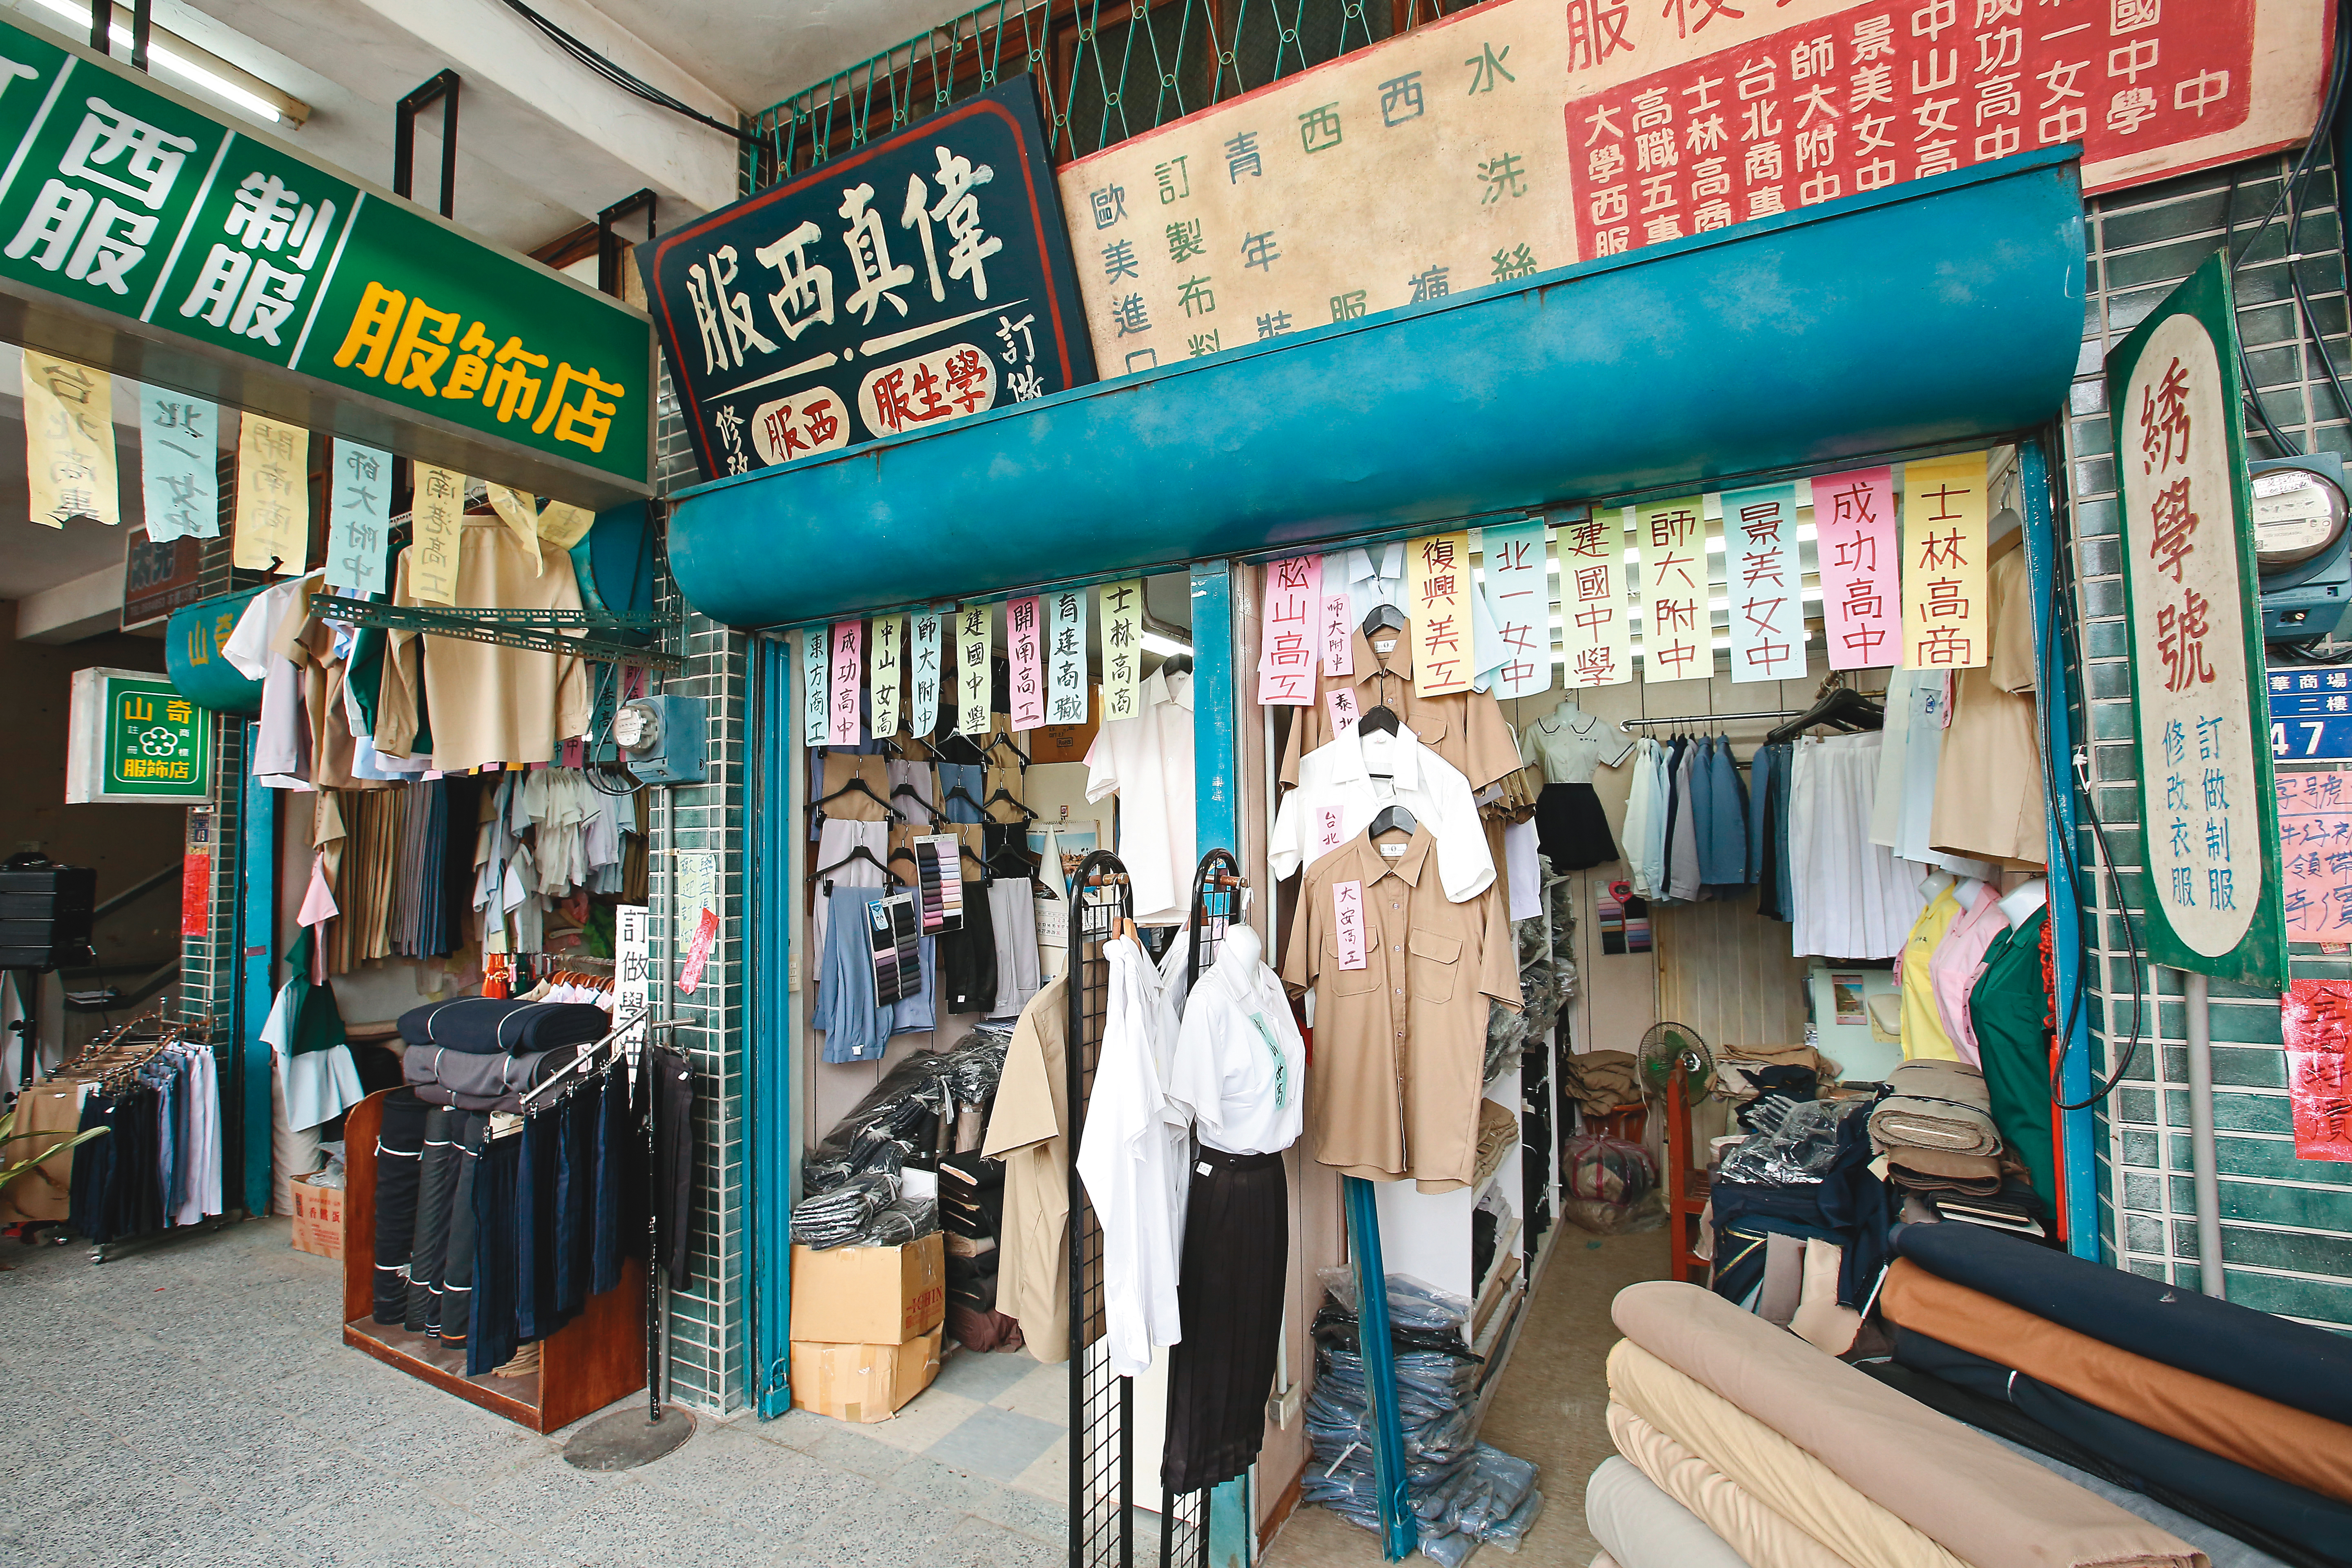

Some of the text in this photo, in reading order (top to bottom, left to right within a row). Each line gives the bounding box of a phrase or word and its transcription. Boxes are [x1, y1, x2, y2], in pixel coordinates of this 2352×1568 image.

[1735, 56, 1786, 222] 台北商專
[1790, 33, 1841, 205] 師大附中
[1850, 13, 1897, 192] 景美女中
[2035, 0, 2092, 144] 一女中
[4, 96, 196, 296] 西服
[1465, 42, 1538, 285] 水洗絲
[1584, 104, 1628, 257] 大學西服
[1632, 86, 1684, 245] 高職五專
[1682, 75, 1732, 234] 士林高商
[180, 171, 336, 347] 制服
[332, 281, 625, 453] 服飾店
[1265, 556, 1312, 700] 松山高工
[1421, 538, 1466, 690] 復興美工
[1497, 540, 1537, 693] 北一女中
[1568, 522, 1615, 687] 建國中學
[1651, 510, 1698, 679] 師大附中
[1740, 502, 1790, 675] 景美女中
[1832, 481, 1886, 664] 成功高中
[1917, 483, 1971, 666] 士林高商
[125, 697, 192, 724] 山奇
[808, 633, 825, 743] 東方商工
[837, 629, 856, 744] 成功高中
[876, 620, 895, 735] 中山女高
[917, 618, 937, 735] 師大附中
[962, 608, 986, 733] 建國中學
[1014, 601, 1039, 724] 開南高工
[1054, 593, 1082, 721] 育達商職
[1106, 586, 1134, 715] 士林高商
[2270, 672, 2347, 691] 華商場
[2299, 695, 2348, 712] 二樓
[124, 759, 190, 779] 服飾店
[1323, 811, 1340, 846] 台北
[2162, 718, 2196, 907] 修改衣服
[2196, 715, 2236, 911] 訂做制服
[1339, 886, 1361, 965] 大安高工
